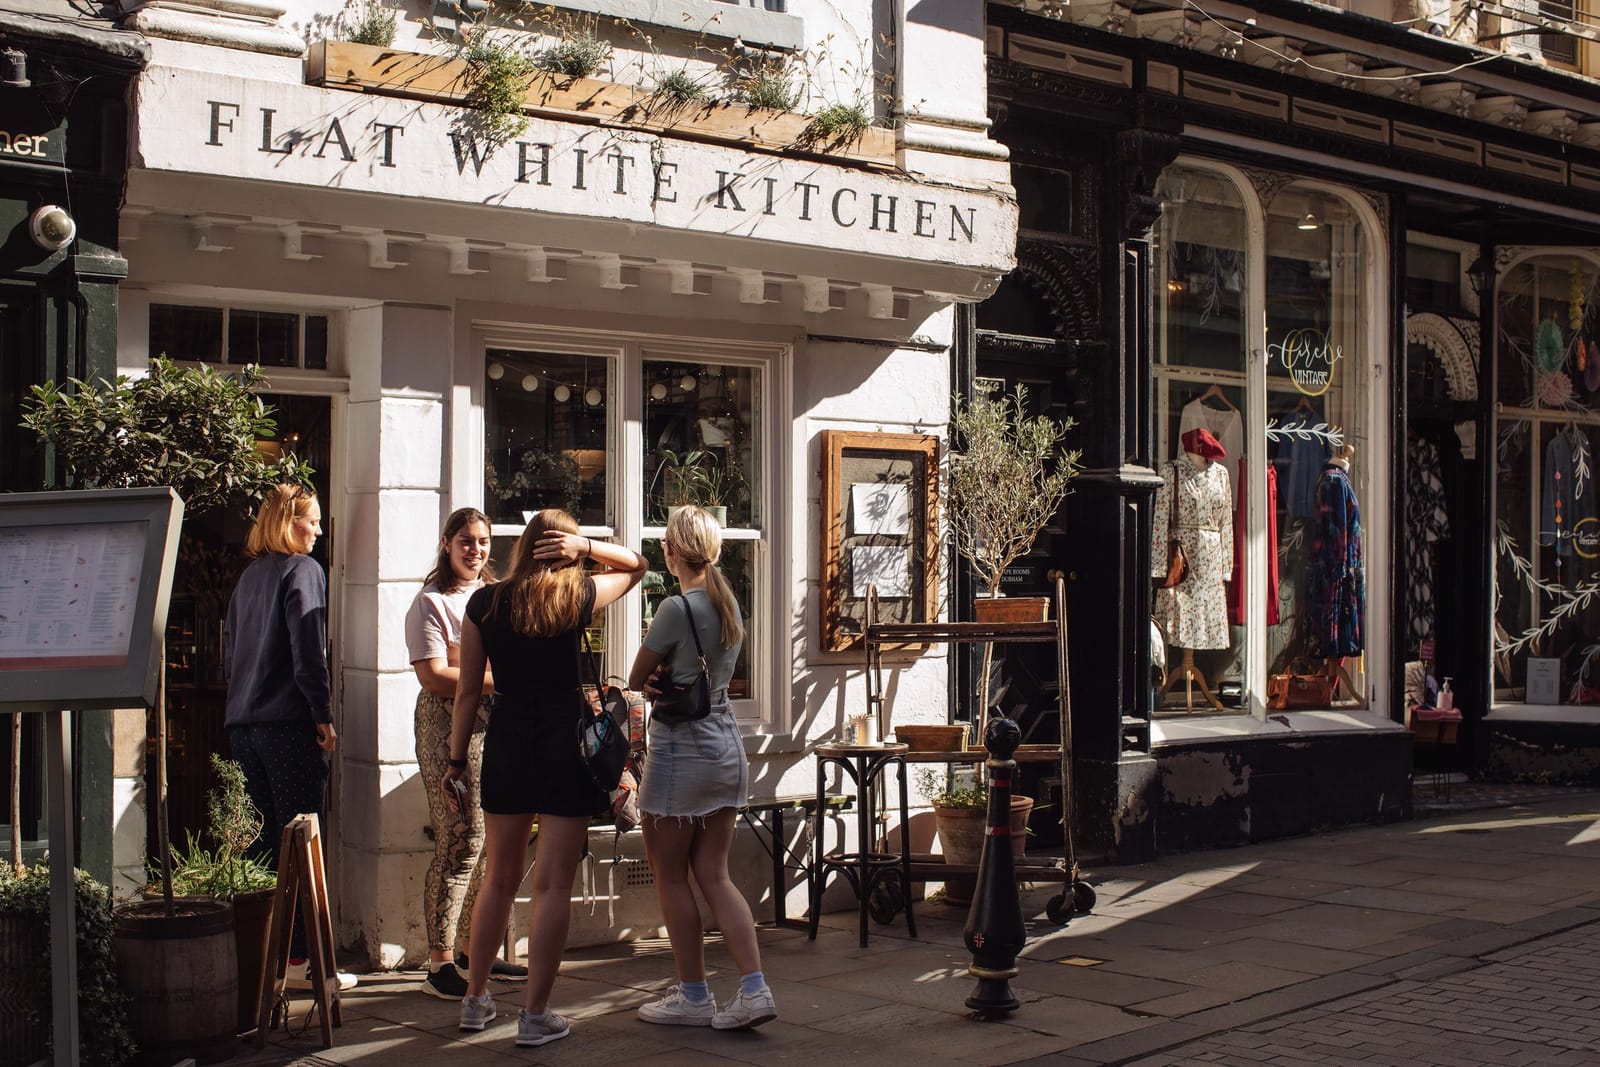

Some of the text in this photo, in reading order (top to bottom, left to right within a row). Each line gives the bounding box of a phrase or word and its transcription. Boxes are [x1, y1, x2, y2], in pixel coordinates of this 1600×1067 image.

[205, 100, 977, 243] FLAT WHITE KITCHEN
[1267, 326, 1344, 369] Circle
[1294, 369, 1329, 385] VINTAGE
